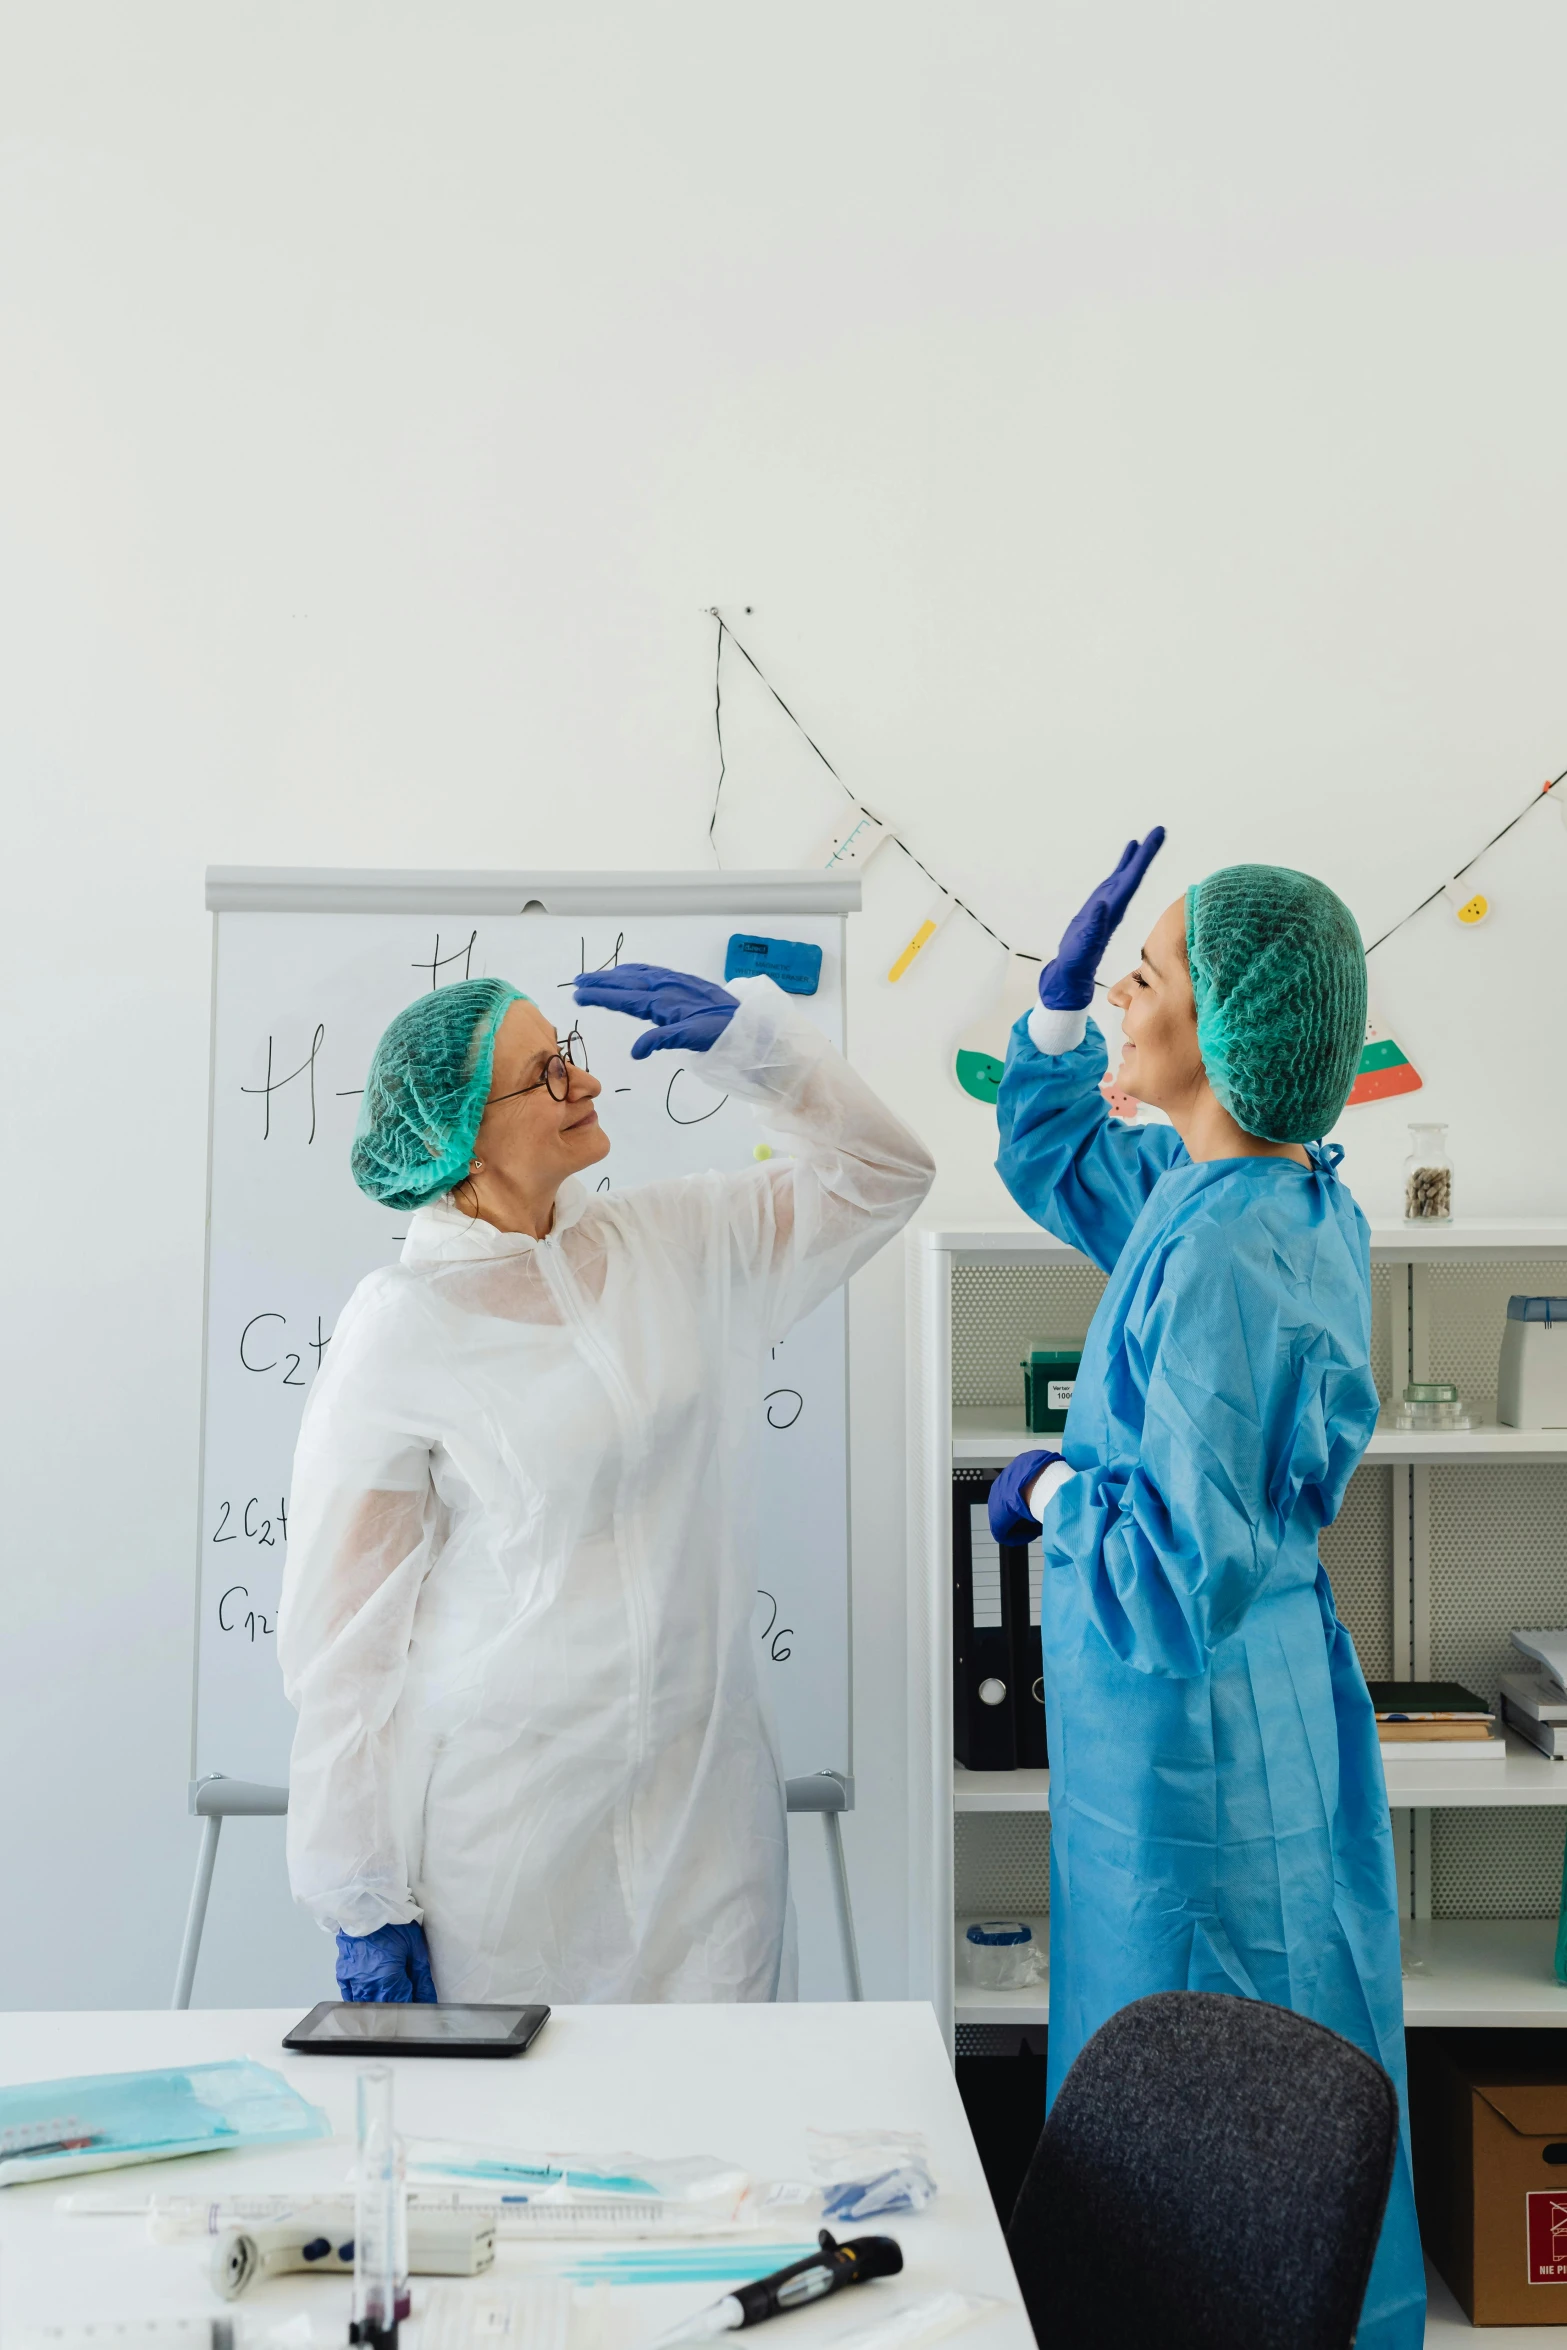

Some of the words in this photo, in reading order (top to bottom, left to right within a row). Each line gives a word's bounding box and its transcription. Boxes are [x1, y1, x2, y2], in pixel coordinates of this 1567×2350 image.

[755, 961, 791, 972] MAGNETIC
[781, 973, 809, 983] ERASER
[241, 1023, 325, 1145] H
[1539, 2265, 1555, 2275] NIE
[1557, 2265, 1567, 2275] PI
